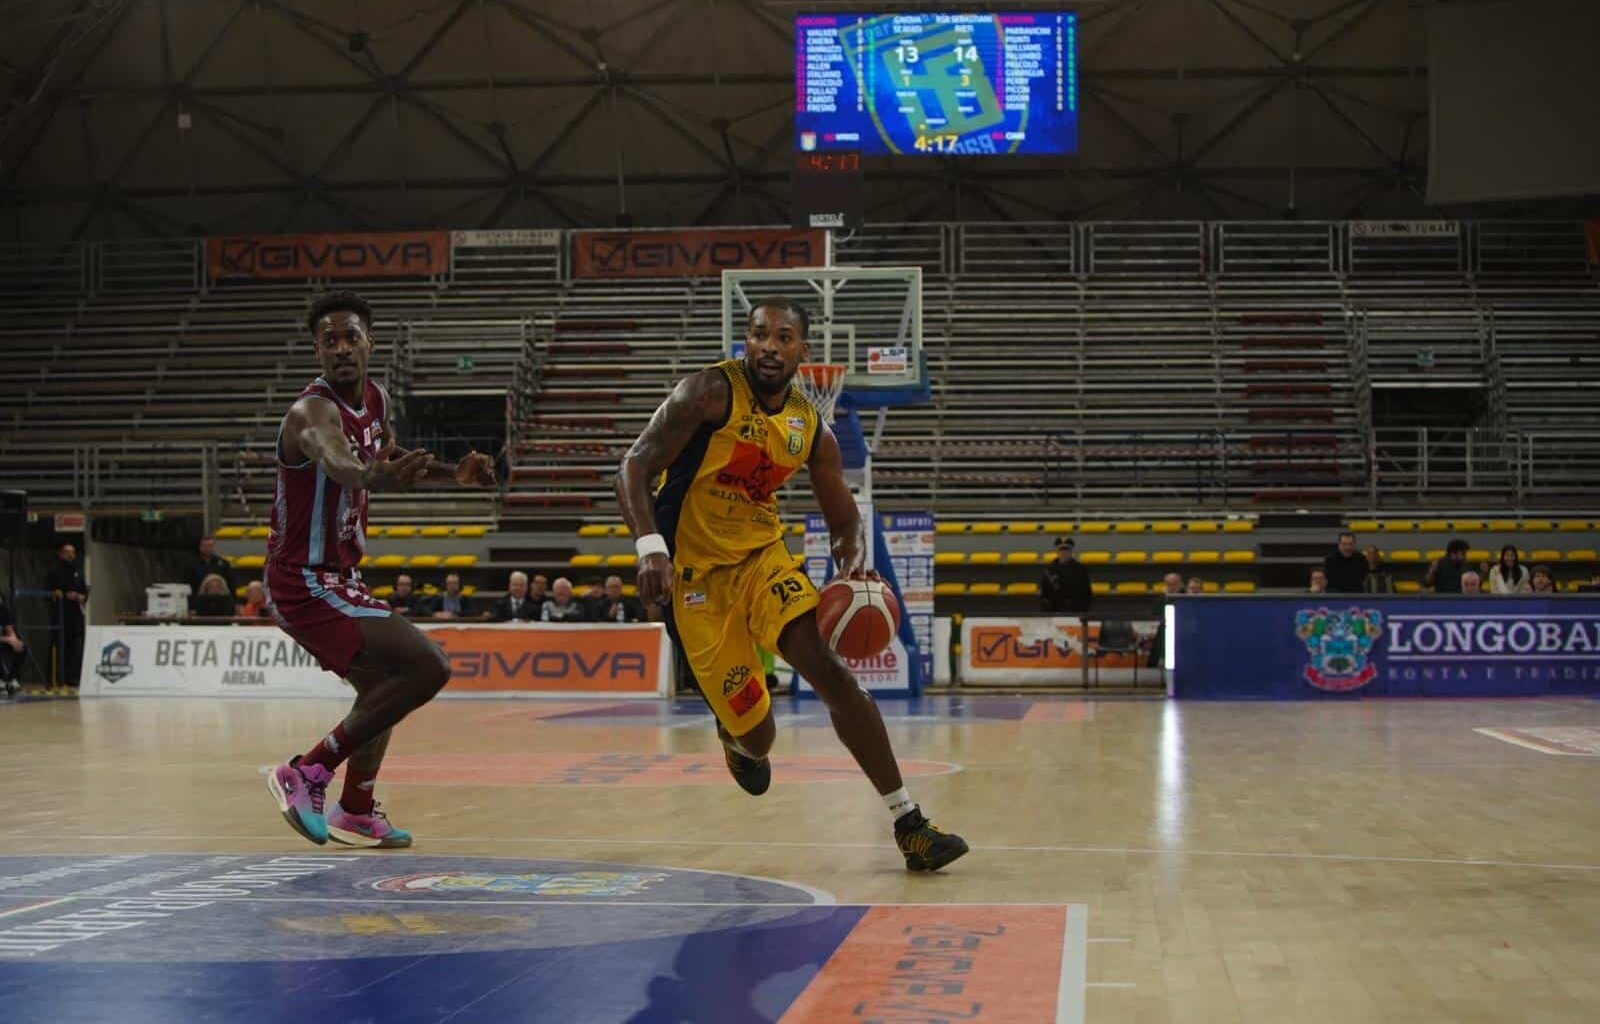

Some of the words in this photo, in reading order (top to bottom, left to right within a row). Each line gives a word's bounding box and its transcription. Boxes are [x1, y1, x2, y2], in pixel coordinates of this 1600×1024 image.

[894, 46, 919, 63] 13
[953, 46, 978, 62] 14
[806, 62, 831, 70] ALLEN
[902, 75, 910, 87] 1
[961, 74, 971, 87] 3
[914, 136, 958, 152] 4:17
[809, 153, 860, 170] 4:17
[259, 241, 434, 270] GIVOVA
[633, 240, 812, 267] GIVOVA
[771, 577, 803, 605] 25
[1387, 621, 1600, 652] LONGOBA
[155, 639, 219, 667] BETA
[230, 639, 321, 667] RICAM
[448, 651, 646, 679] GIVOVA
[222, 671, 266, 685] ARENA
